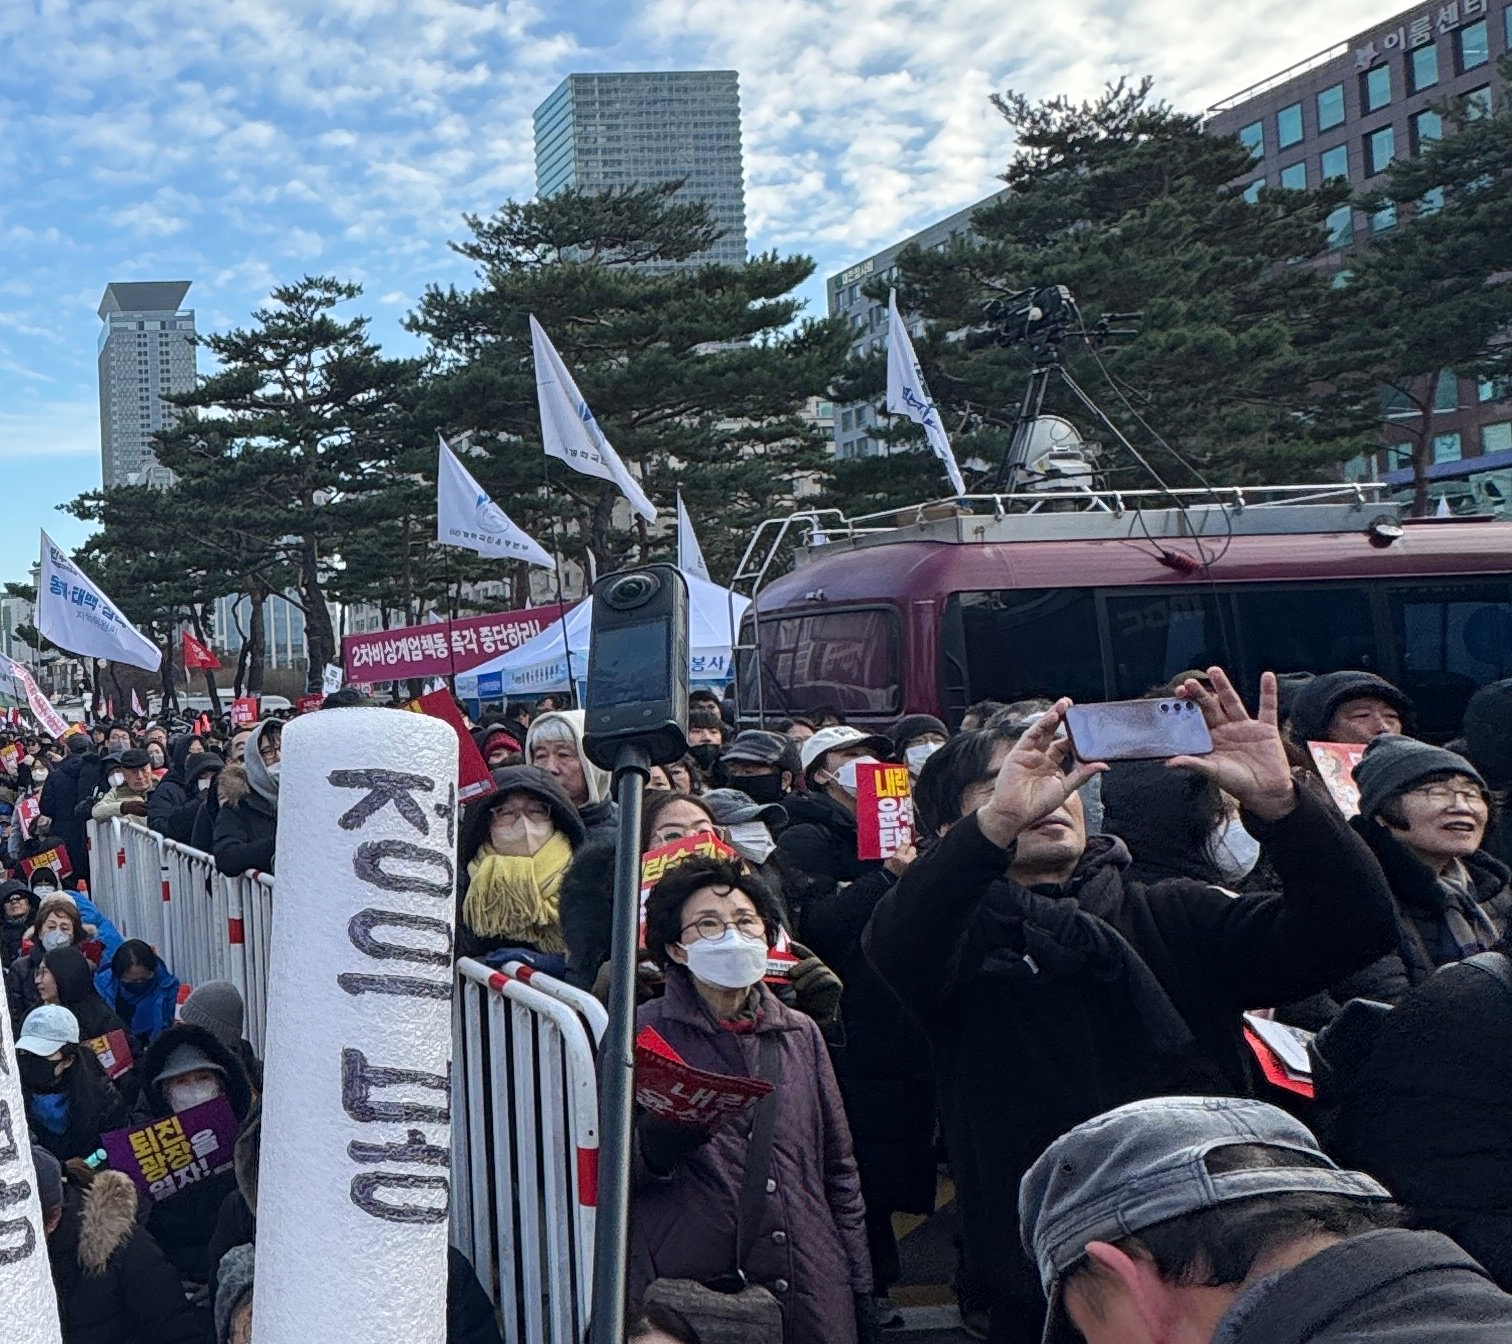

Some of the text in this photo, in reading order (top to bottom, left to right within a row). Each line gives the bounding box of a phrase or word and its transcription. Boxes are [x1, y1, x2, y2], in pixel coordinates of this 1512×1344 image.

[351, 619, 541, 667] 2차비상계엄책동 즉각 중단하라!
[128, 1115, 187, 1157] 퇴진
[149, 1156, 212, 1202] 열자!
